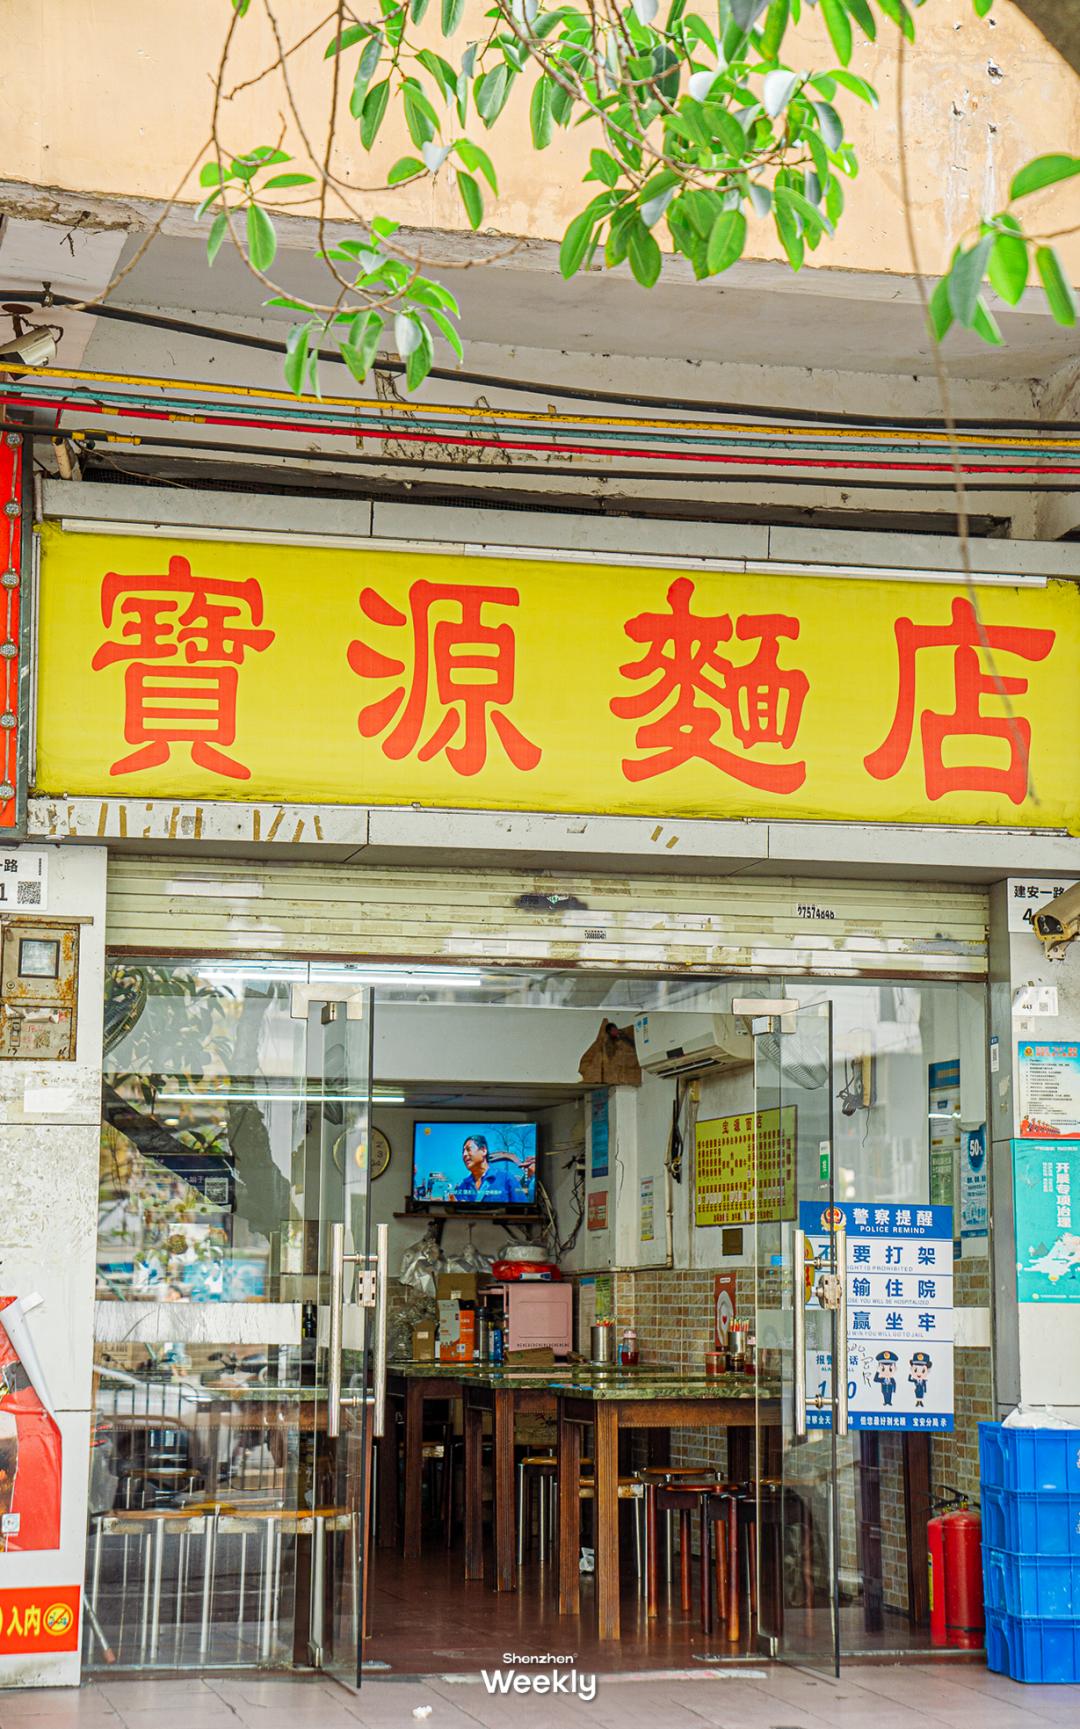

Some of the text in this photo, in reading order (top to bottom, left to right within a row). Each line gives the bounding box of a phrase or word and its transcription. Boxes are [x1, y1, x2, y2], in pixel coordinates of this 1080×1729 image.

[92, 555, 1056, 806] 寶源麵店
[0, 858, 18, 873] 路
[852, 1208, 933, 1227] 警察提醒
[860, 1225, 925, 1234] POLICE REMIND
[816, 1354, 859, 1366] 报警话
[818, 1380, 857, 1399] 10
